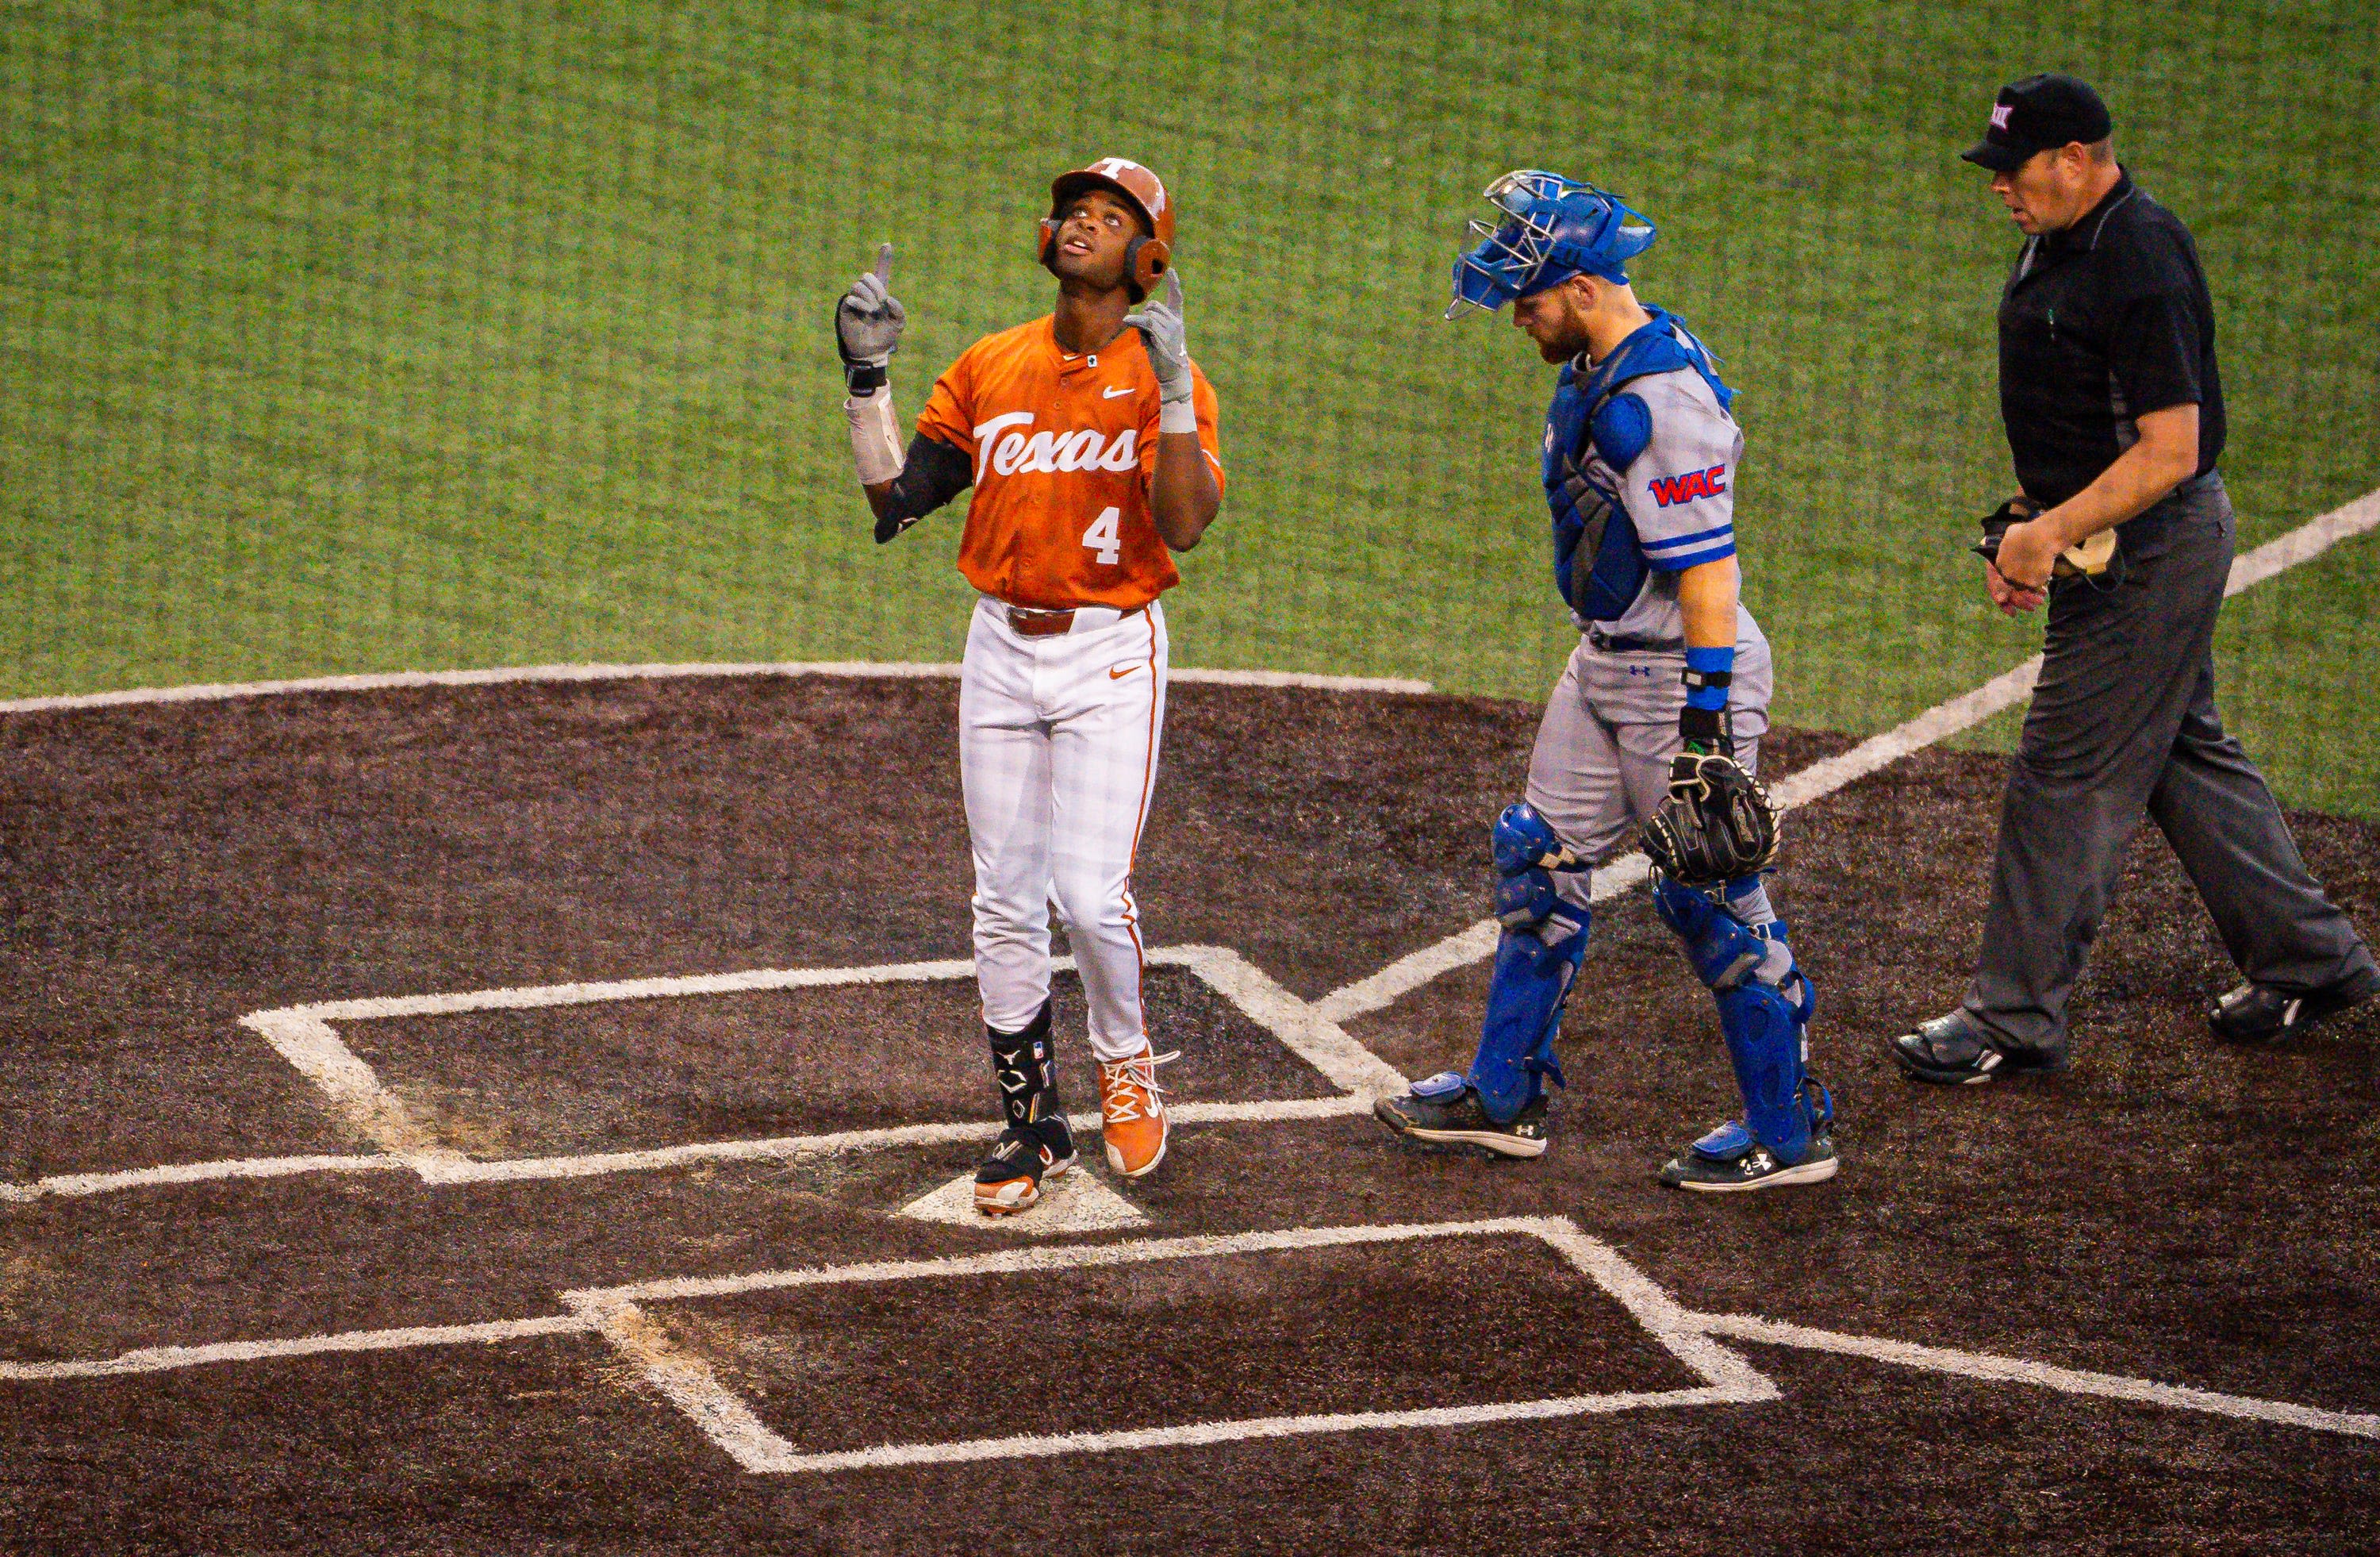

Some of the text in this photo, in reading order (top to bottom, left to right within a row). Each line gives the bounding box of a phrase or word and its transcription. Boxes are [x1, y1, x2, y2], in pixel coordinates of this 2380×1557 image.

[1100, 157, 1140, 180] T
[973, 413, 1138, 486] Texas
[1648, 464, 1726, 508] WAC
[1082, 506, 1120, 564] 4
